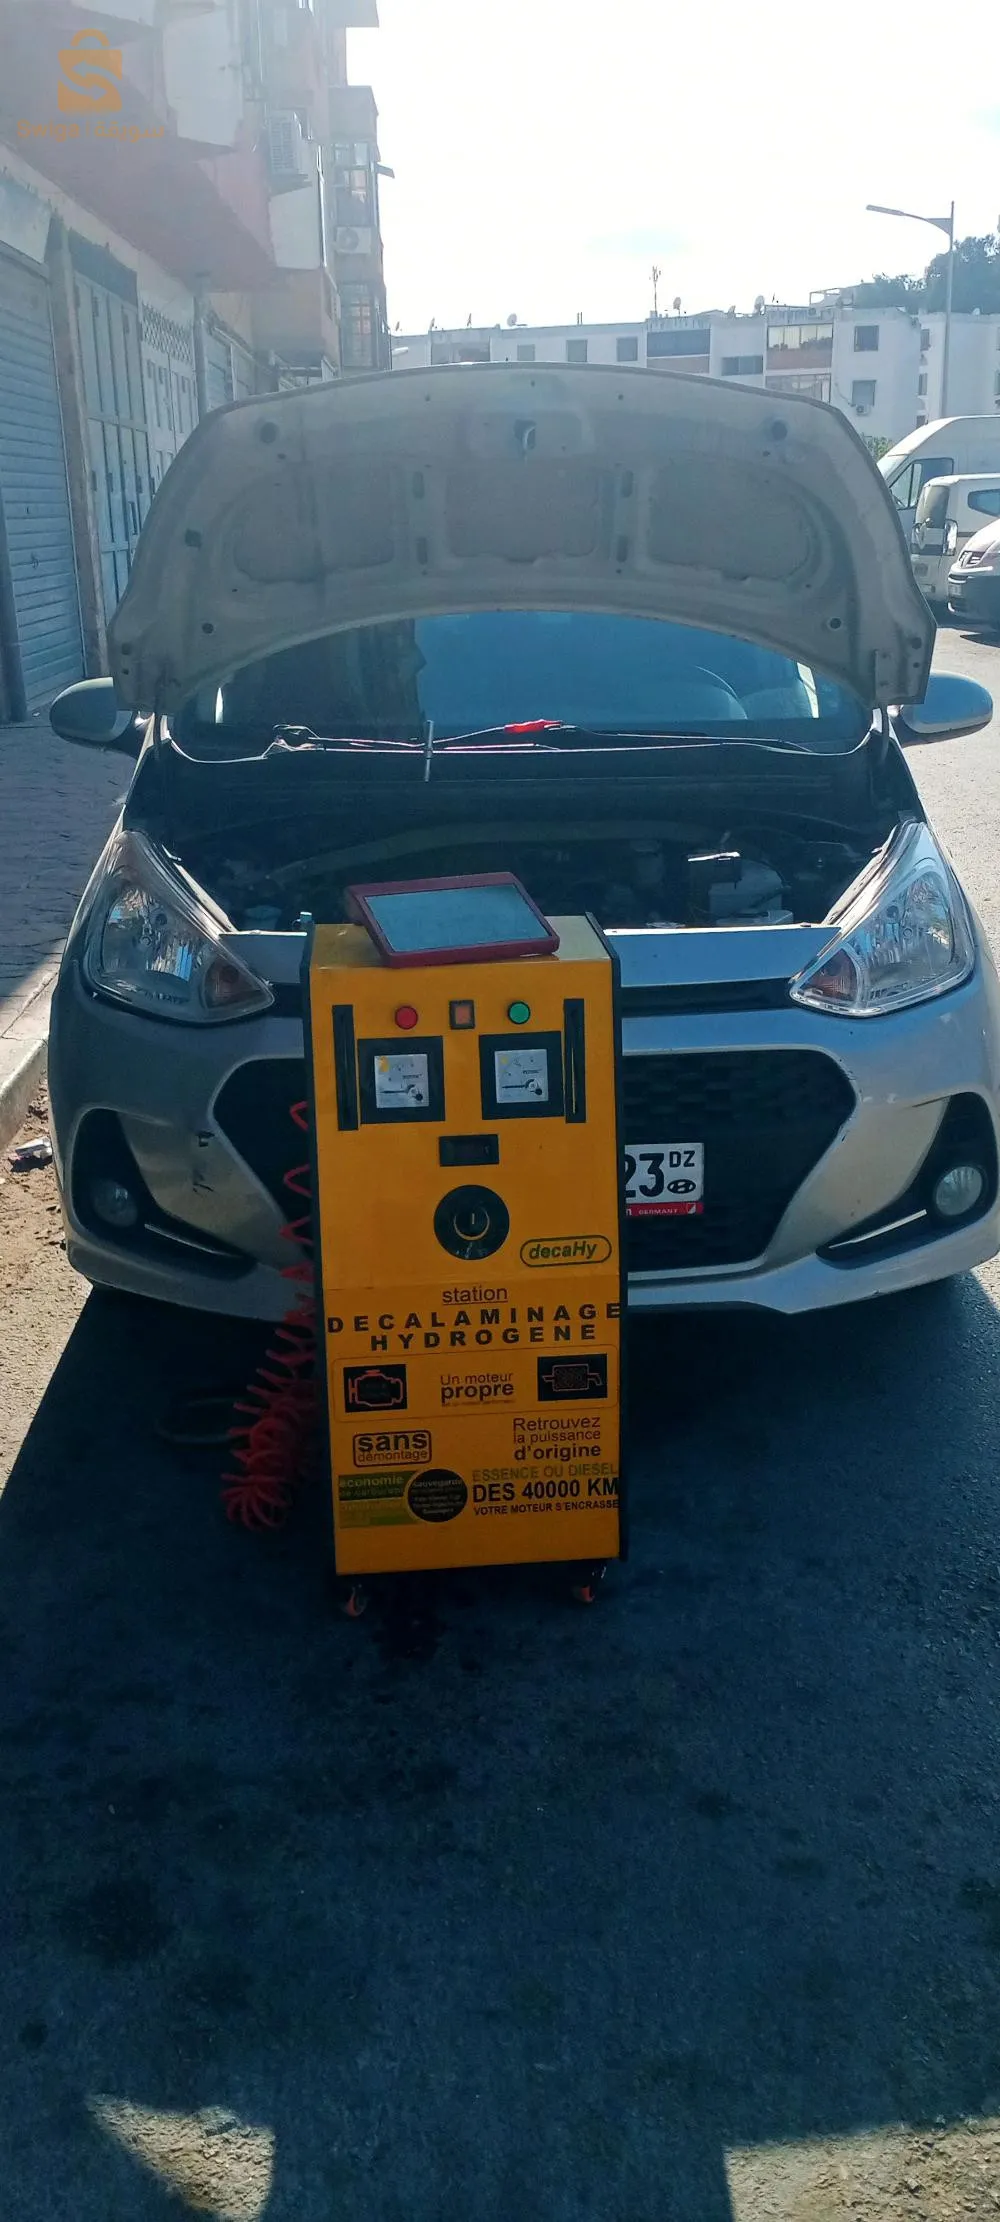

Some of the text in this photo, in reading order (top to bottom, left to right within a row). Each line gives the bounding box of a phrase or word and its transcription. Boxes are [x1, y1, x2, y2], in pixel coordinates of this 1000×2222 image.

[669, 1151, 695, 1168] DZ
[638, 1208, 678, 1216] GERMANY
[529, 1241, 597, 1259] decaHy
[442, 1286, 508, 1304] station
[327, 1303, 620, 1333] DECALAMINAGE
[371, 1324, 596, 1351] HYDROGENE
[440, 1373, 514, 1386] Un moteur
[441, 1383, 514, 1403] propre
[513, 1416, 601, 1431] Retrouvez
[358, 1433, 428, 1452] sans
[514, 1430, 600, 1445] la puissance
[514, 1444, 601, 1461] d'origine
[472, 1463, 618, 1482] ESSENCE OU DIESEL
[473, 1477, 620, 1502] DES 40000 KM
[474, 1505, 508, 1516] VOTRE
[511, 1502, 553, 1514] MOTEUR
